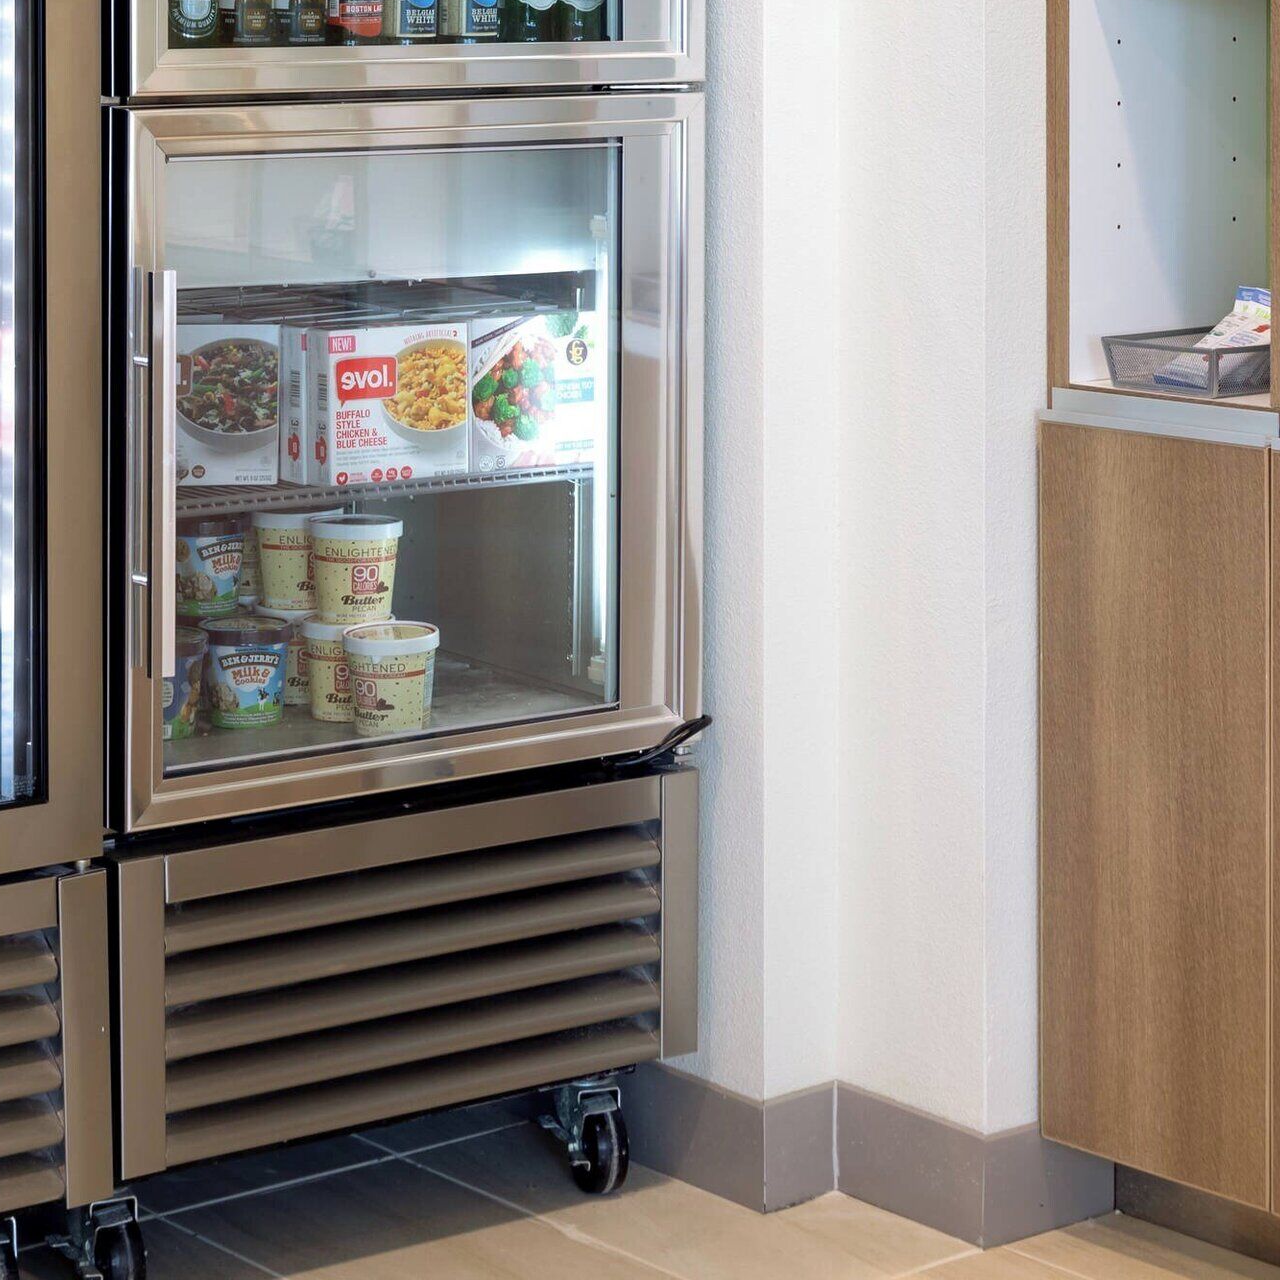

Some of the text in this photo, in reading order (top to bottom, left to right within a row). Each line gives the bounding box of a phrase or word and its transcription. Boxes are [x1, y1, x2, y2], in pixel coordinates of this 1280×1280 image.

[346, 5, 371, 13] BOSTON
[332, 338, 353, 352] NEW!
[341, 364, 393, 391] evol.
[336, 409, 370, 420] BUFFALO
[336, 420, 360, 429] STYLE
[336, 427, 378, 439] CHICKEN &
[336, 436, 388, 449] BLUE CHEESE
[353, 565, 378, 582] 90
[341, 595, 384, 606] Butter
[231, 668, 260, 681] Milk
[234, 676, 267, 686] Cookies
[355, 680, 376, 696] 90
